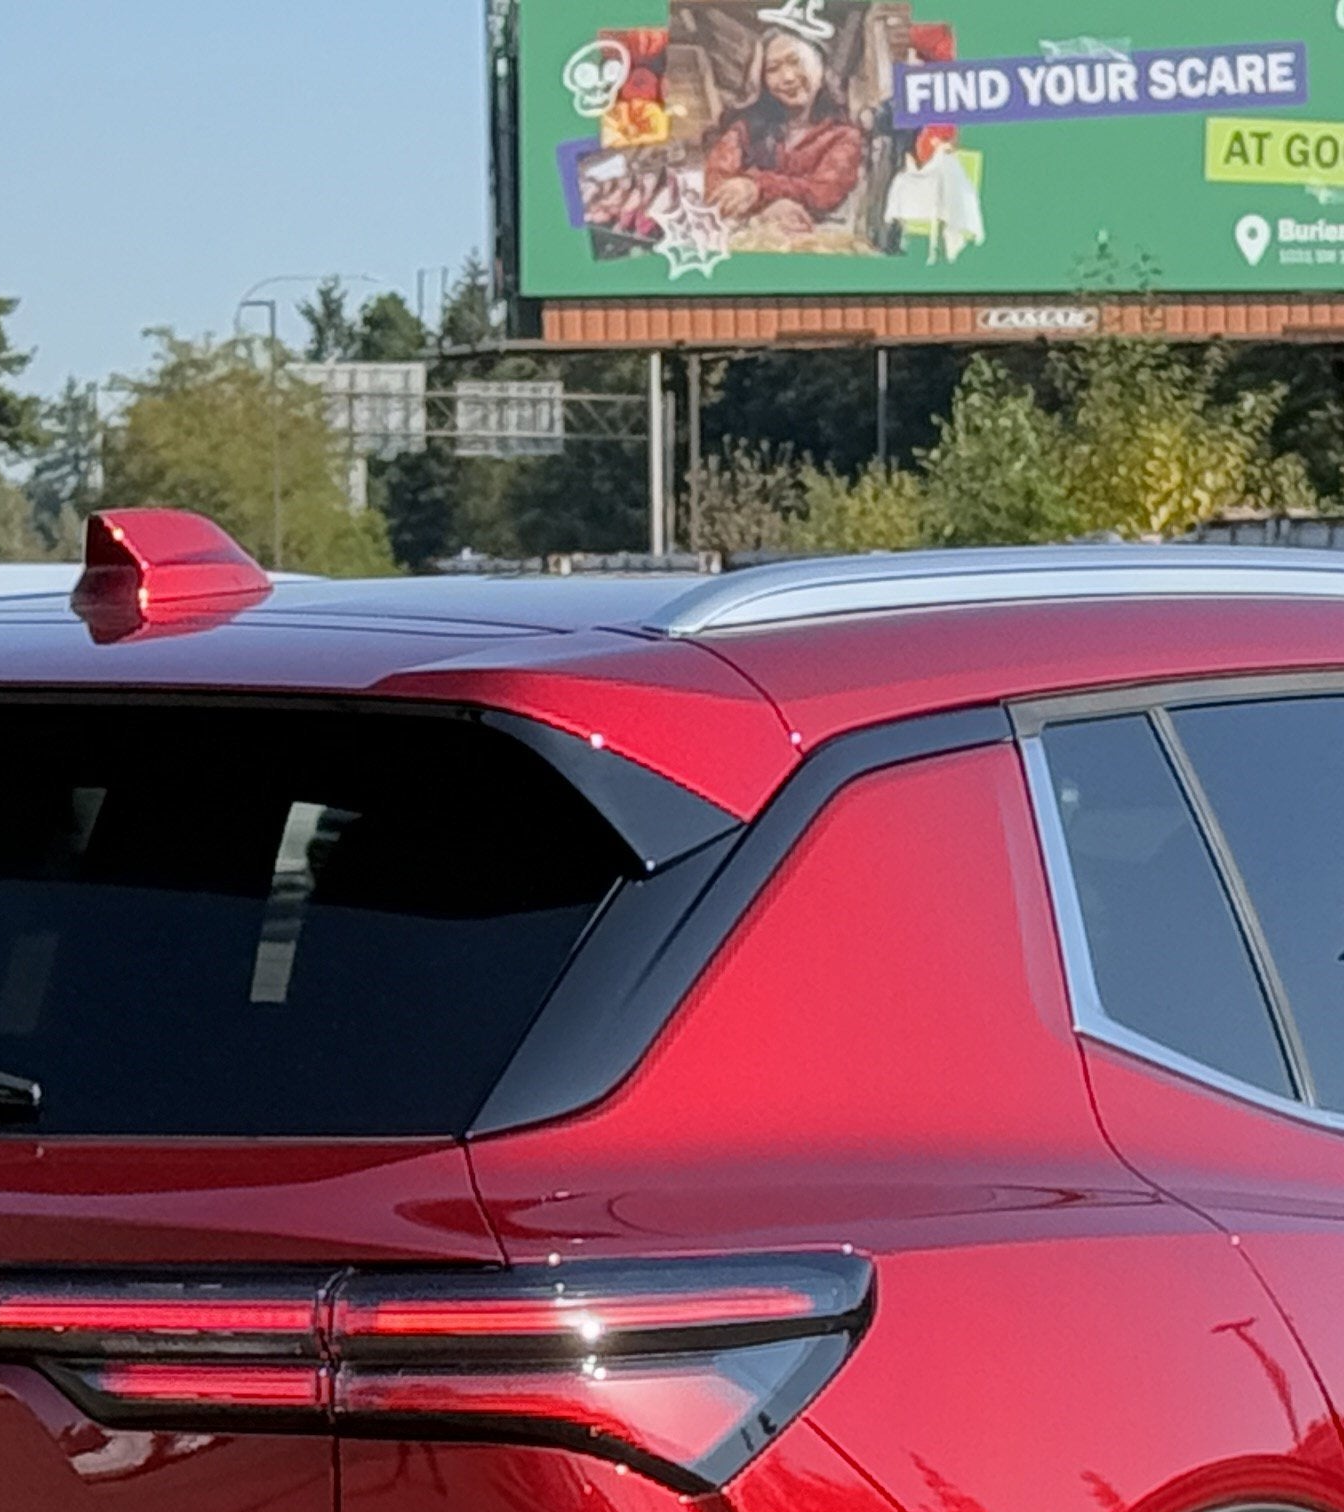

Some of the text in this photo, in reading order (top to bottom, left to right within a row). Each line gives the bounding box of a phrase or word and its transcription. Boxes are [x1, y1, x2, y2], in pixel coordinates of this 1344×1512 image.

[905, 51, 1297, 114] FIND YOUR SCARE
[1223, 131, 1273, 166] AT
